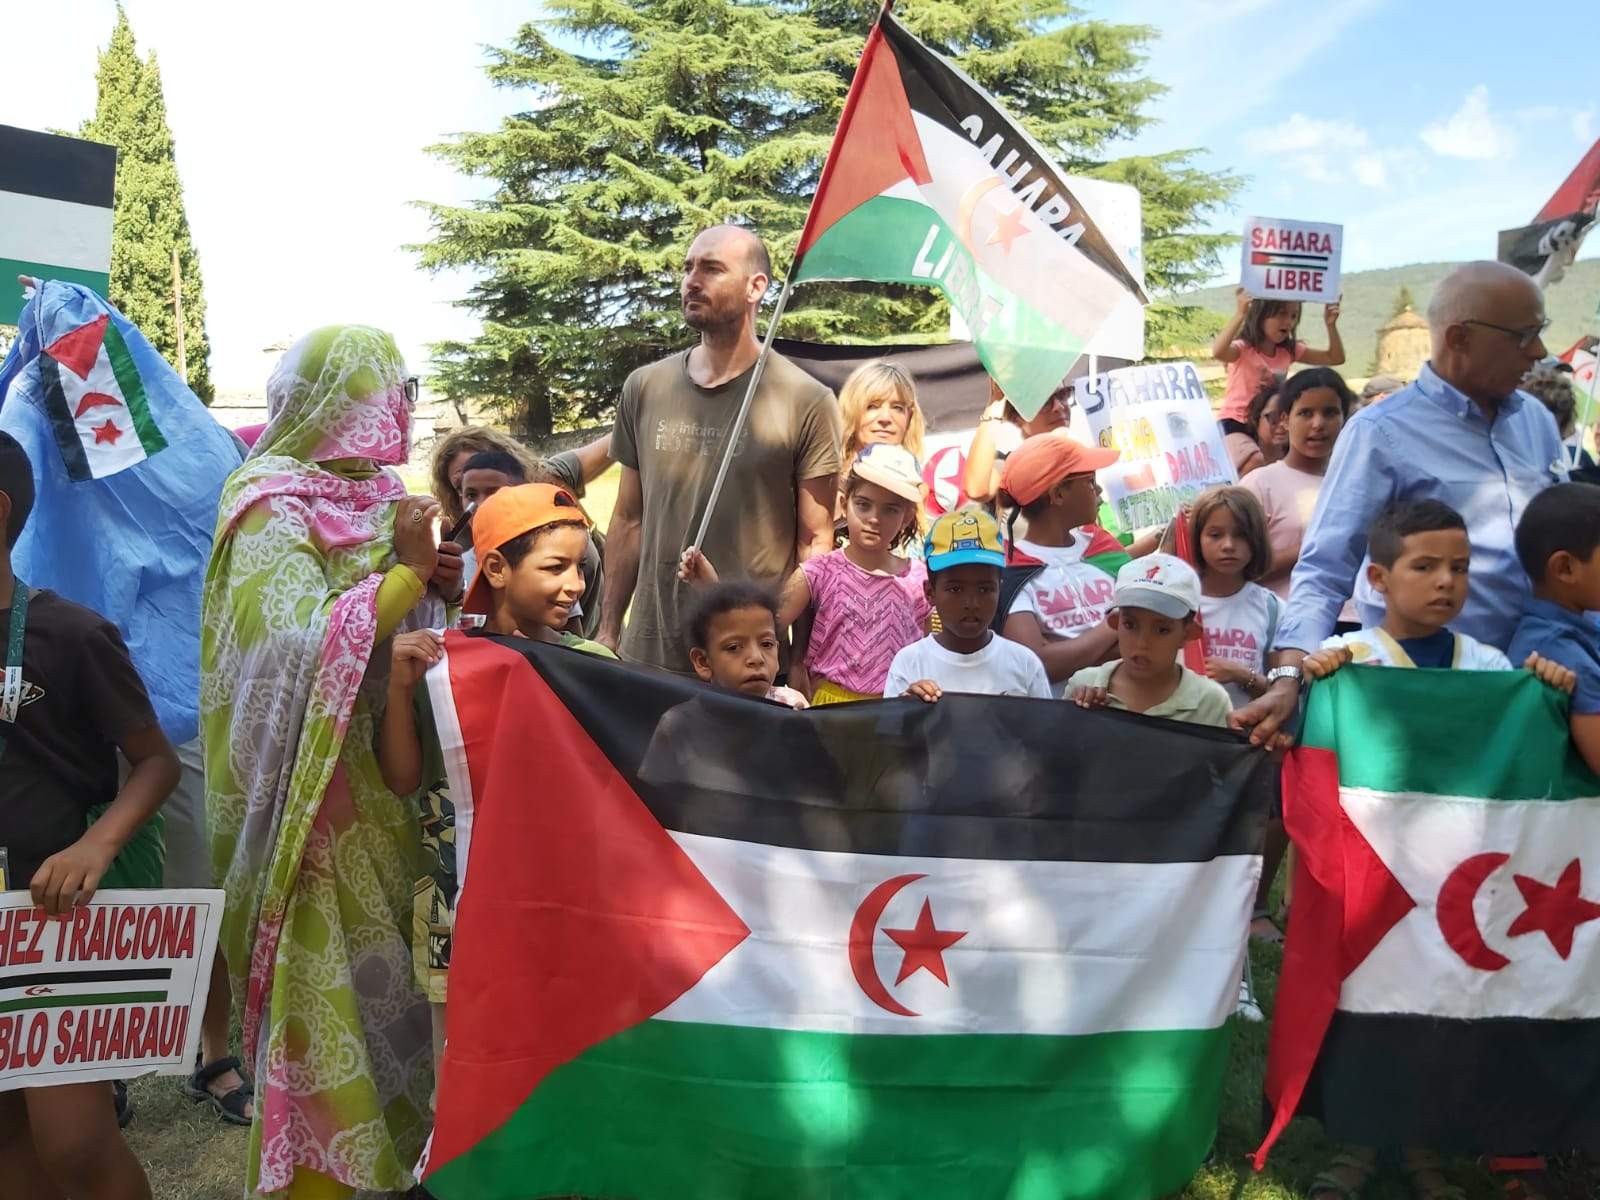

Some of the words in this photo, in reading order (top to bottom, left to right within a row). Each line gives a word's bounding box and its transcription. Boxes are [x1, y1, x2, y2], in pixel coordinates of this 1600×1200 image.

[1251, 227, 1333, 254] SAHARA
[1265, 268, 1323, 292] LIBRE
[1085, 365, 1203, 415] SAHARA
[1035, 578, 1114, 615] SAHAR
[1205, 627, 1257, 650] HARA
[55, 905, 197, 962] TRAICIONA
[0, 1011, 49, 1071] BLO
[53, 1005, 189, 1065] SAHARAUI
